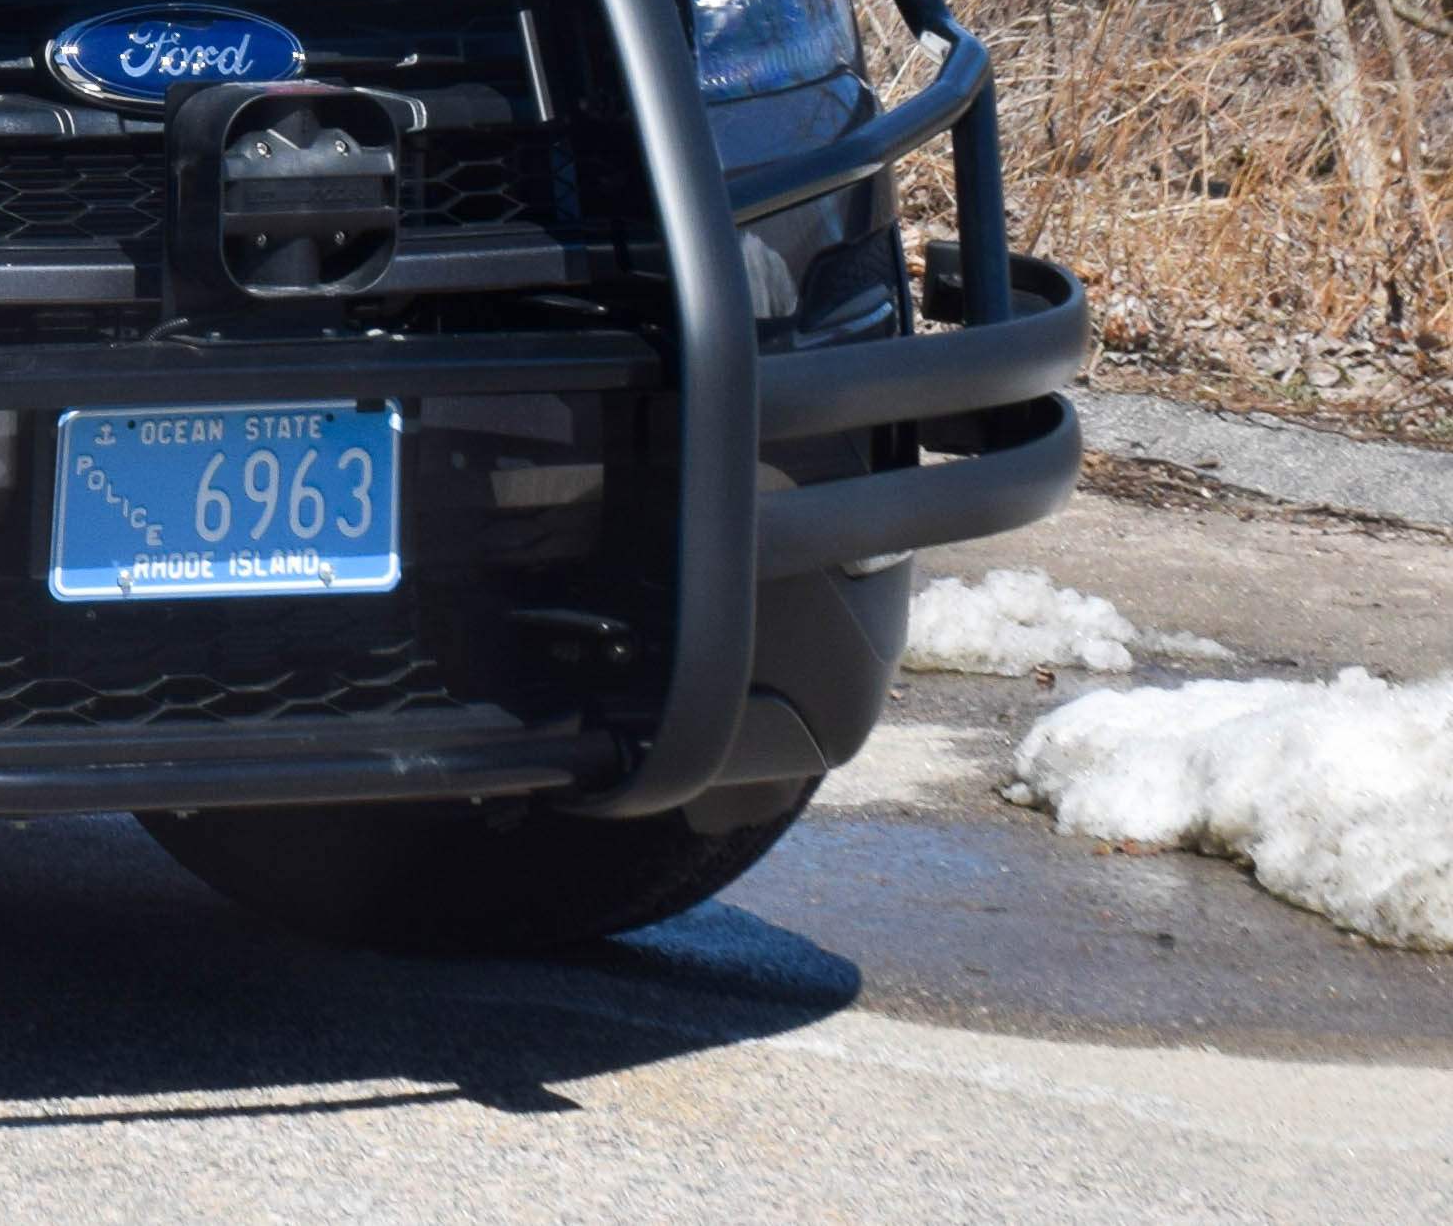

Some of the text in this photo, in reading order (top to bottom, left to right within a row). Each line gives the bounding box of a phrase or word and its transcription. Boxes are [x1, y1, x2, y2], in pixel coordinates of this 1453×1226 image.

[120, 27, 254, 78] Ford
[140, 415, 323, 444] OCEAN STATE
[75, 454, 163, 546] POLICE
[195, 446, 374, 543] 6963
[133, 548, 321, 580] RHODE ISLAND
